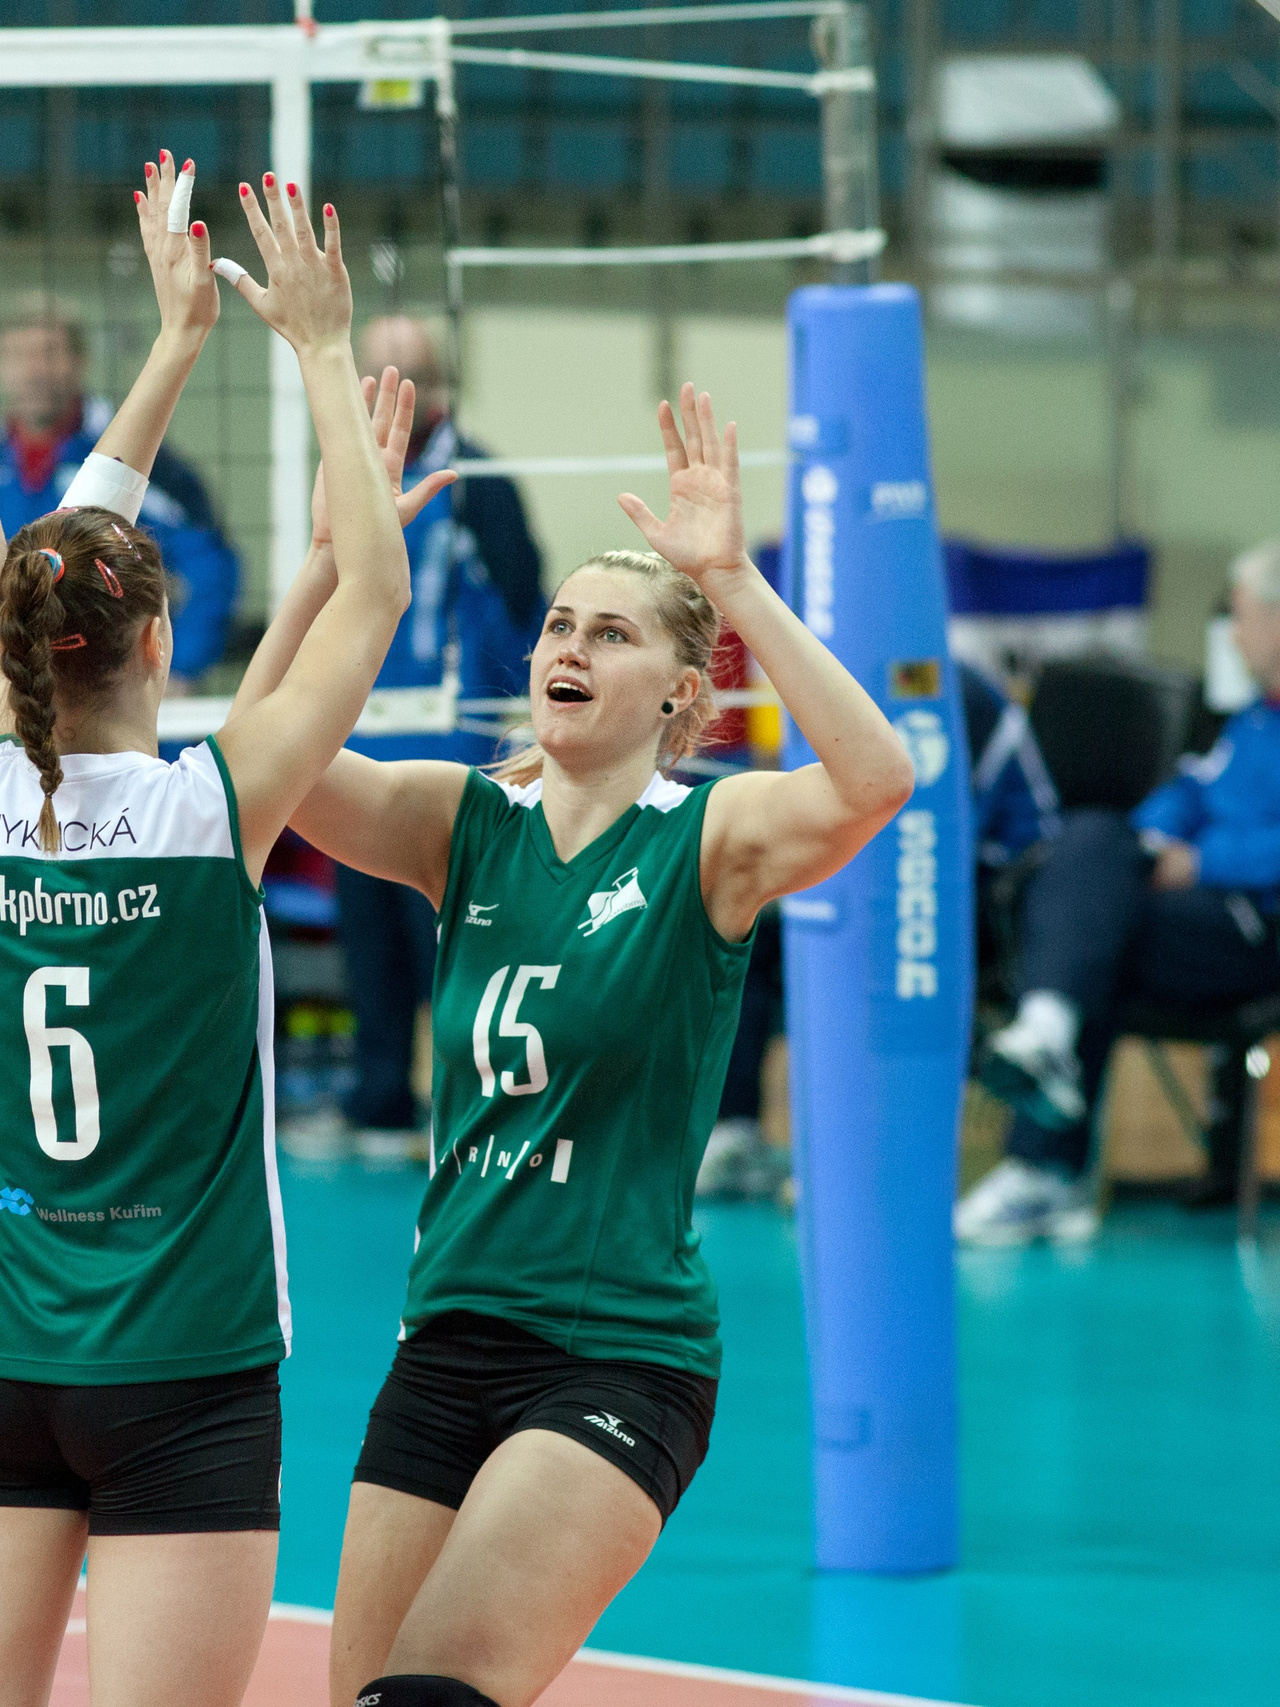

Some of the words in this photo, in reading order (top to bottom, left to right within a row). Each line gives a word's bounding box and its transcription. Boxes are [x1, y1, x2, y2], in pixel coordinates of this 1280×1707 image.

[23, 966, 101, 1161] 6
[472, 964, 562, 1098] 15
[36, 1206, 105, 1223] Wellness
[109, 1203, 162, 1220] Kuřim
